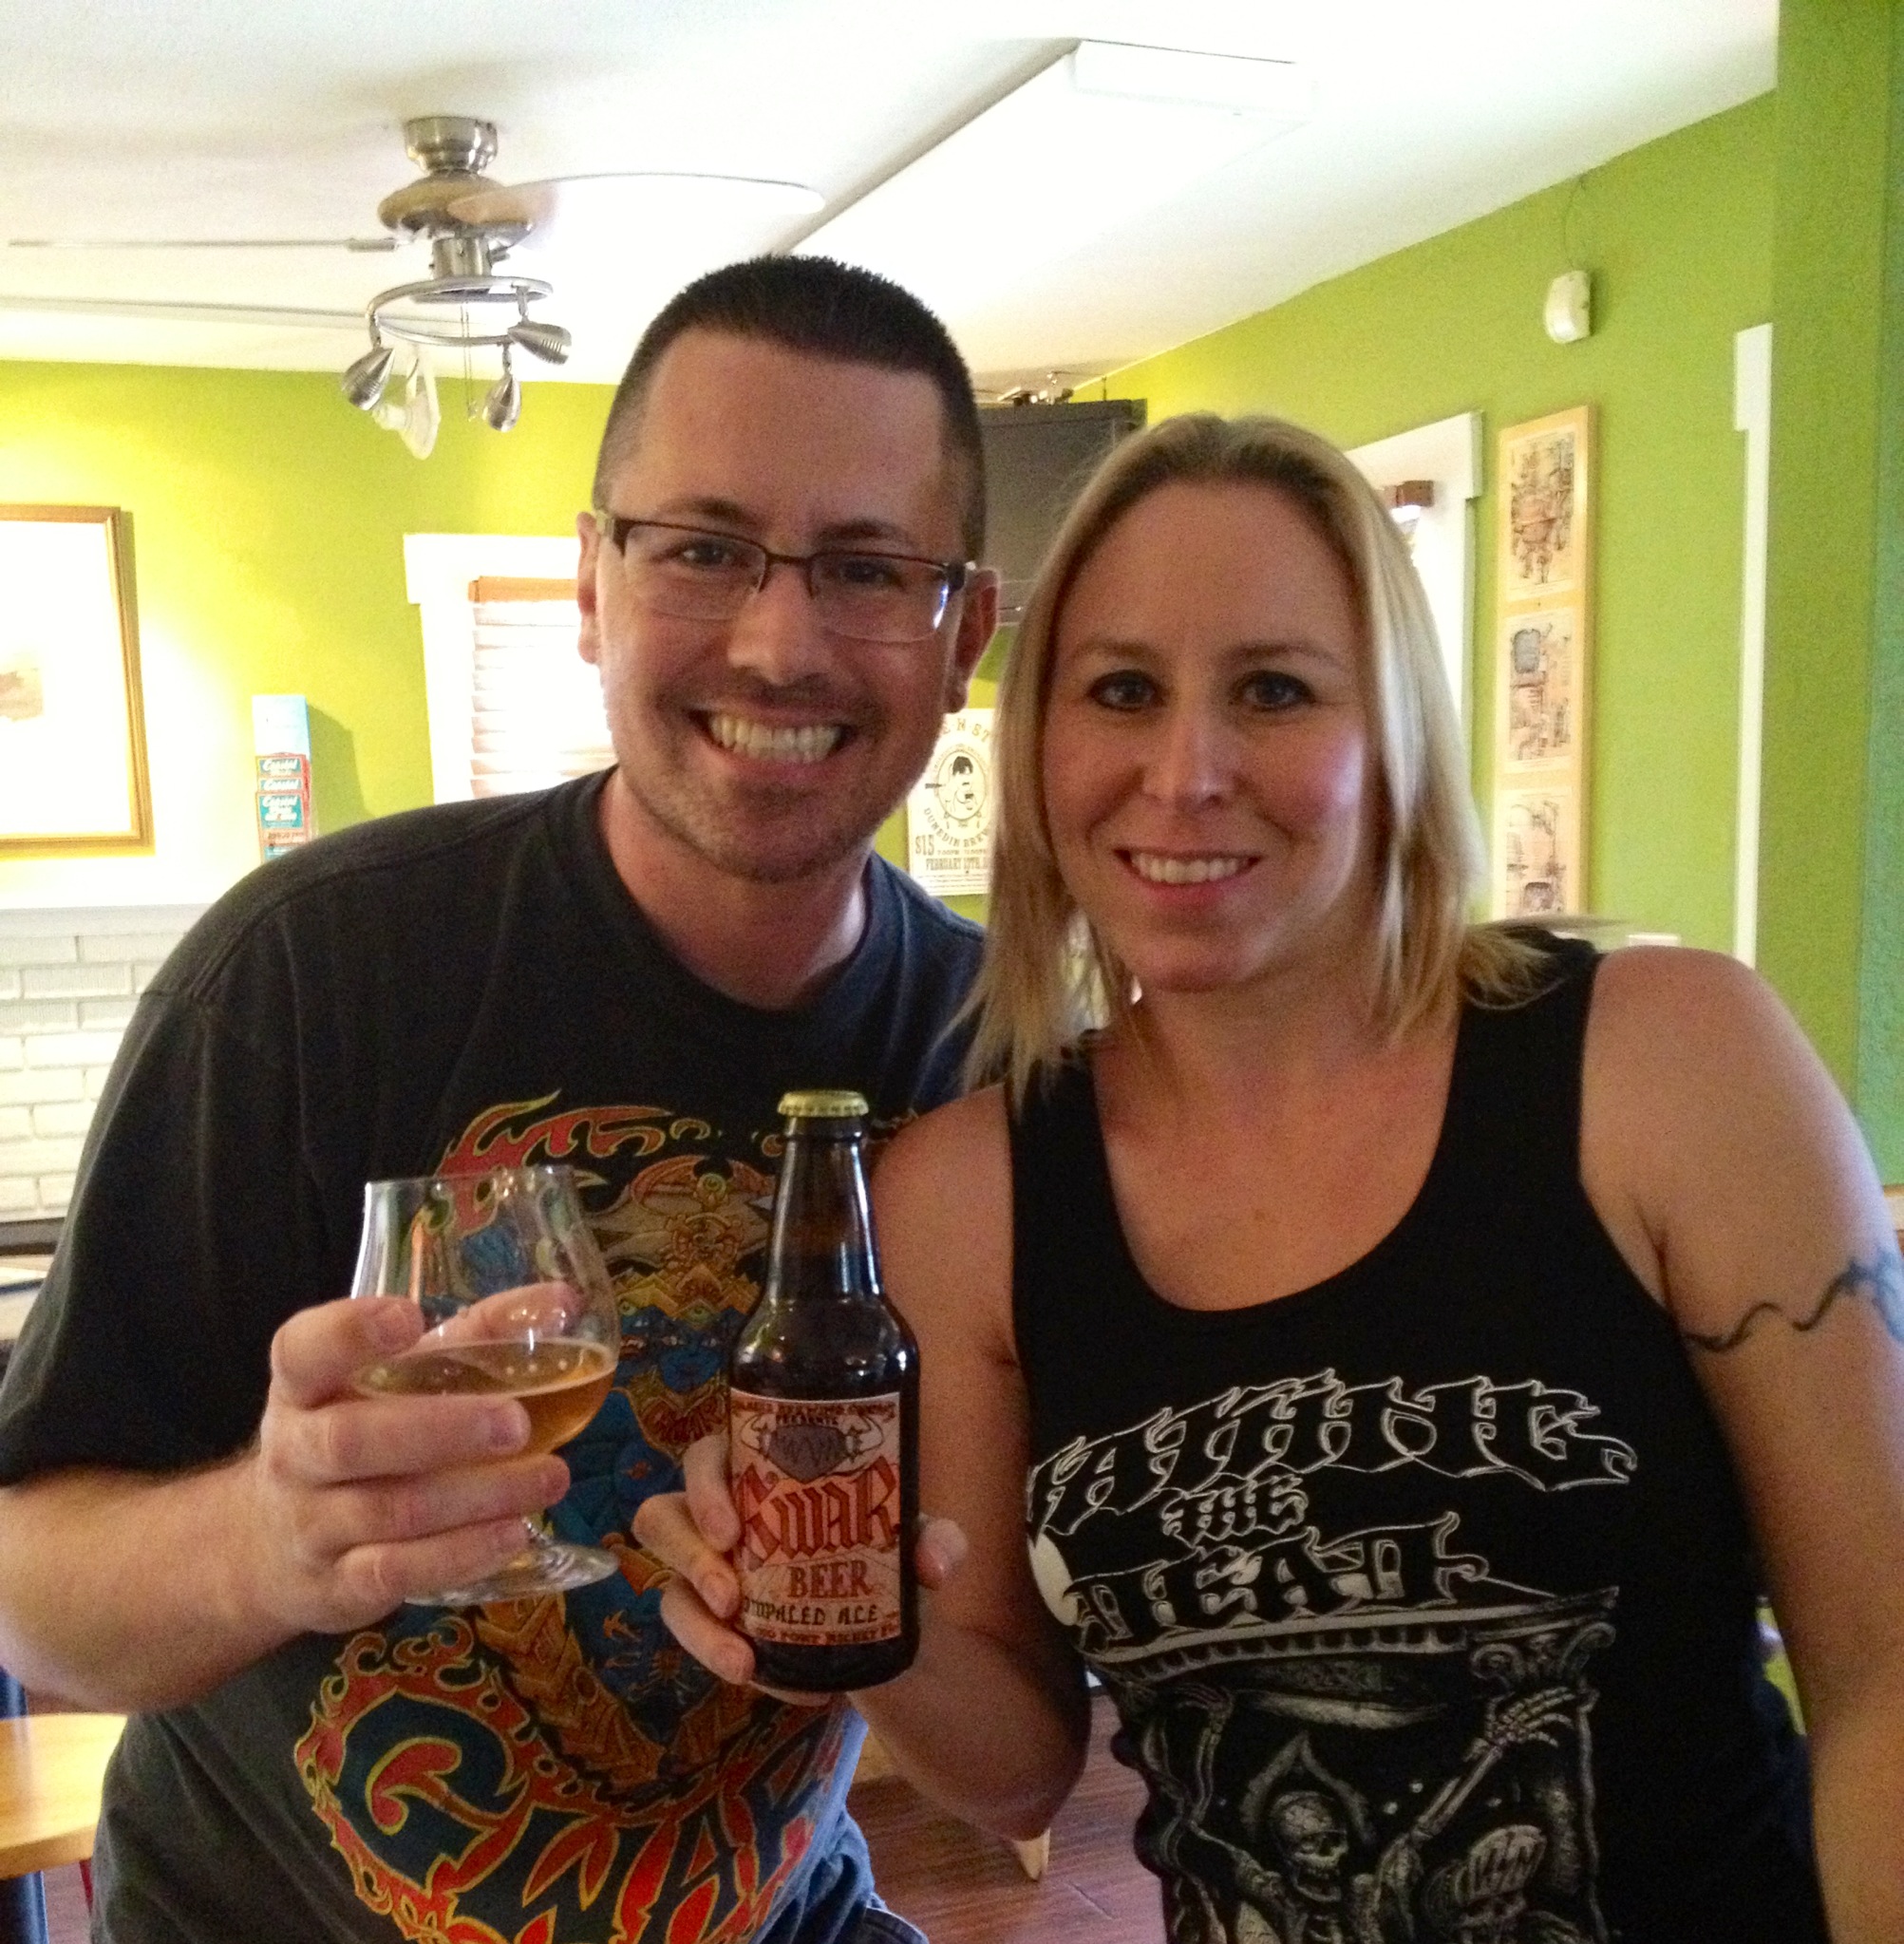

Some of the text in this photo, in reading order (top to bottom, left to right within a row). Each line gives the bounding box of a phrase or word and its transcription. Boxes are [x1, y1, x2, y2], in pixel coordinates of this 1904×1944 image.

[924, 808, 960, 847] DUNEDIN
[787, 1560, 873, 1599] BEER
[838, 1604, 877, 1626] ALE
